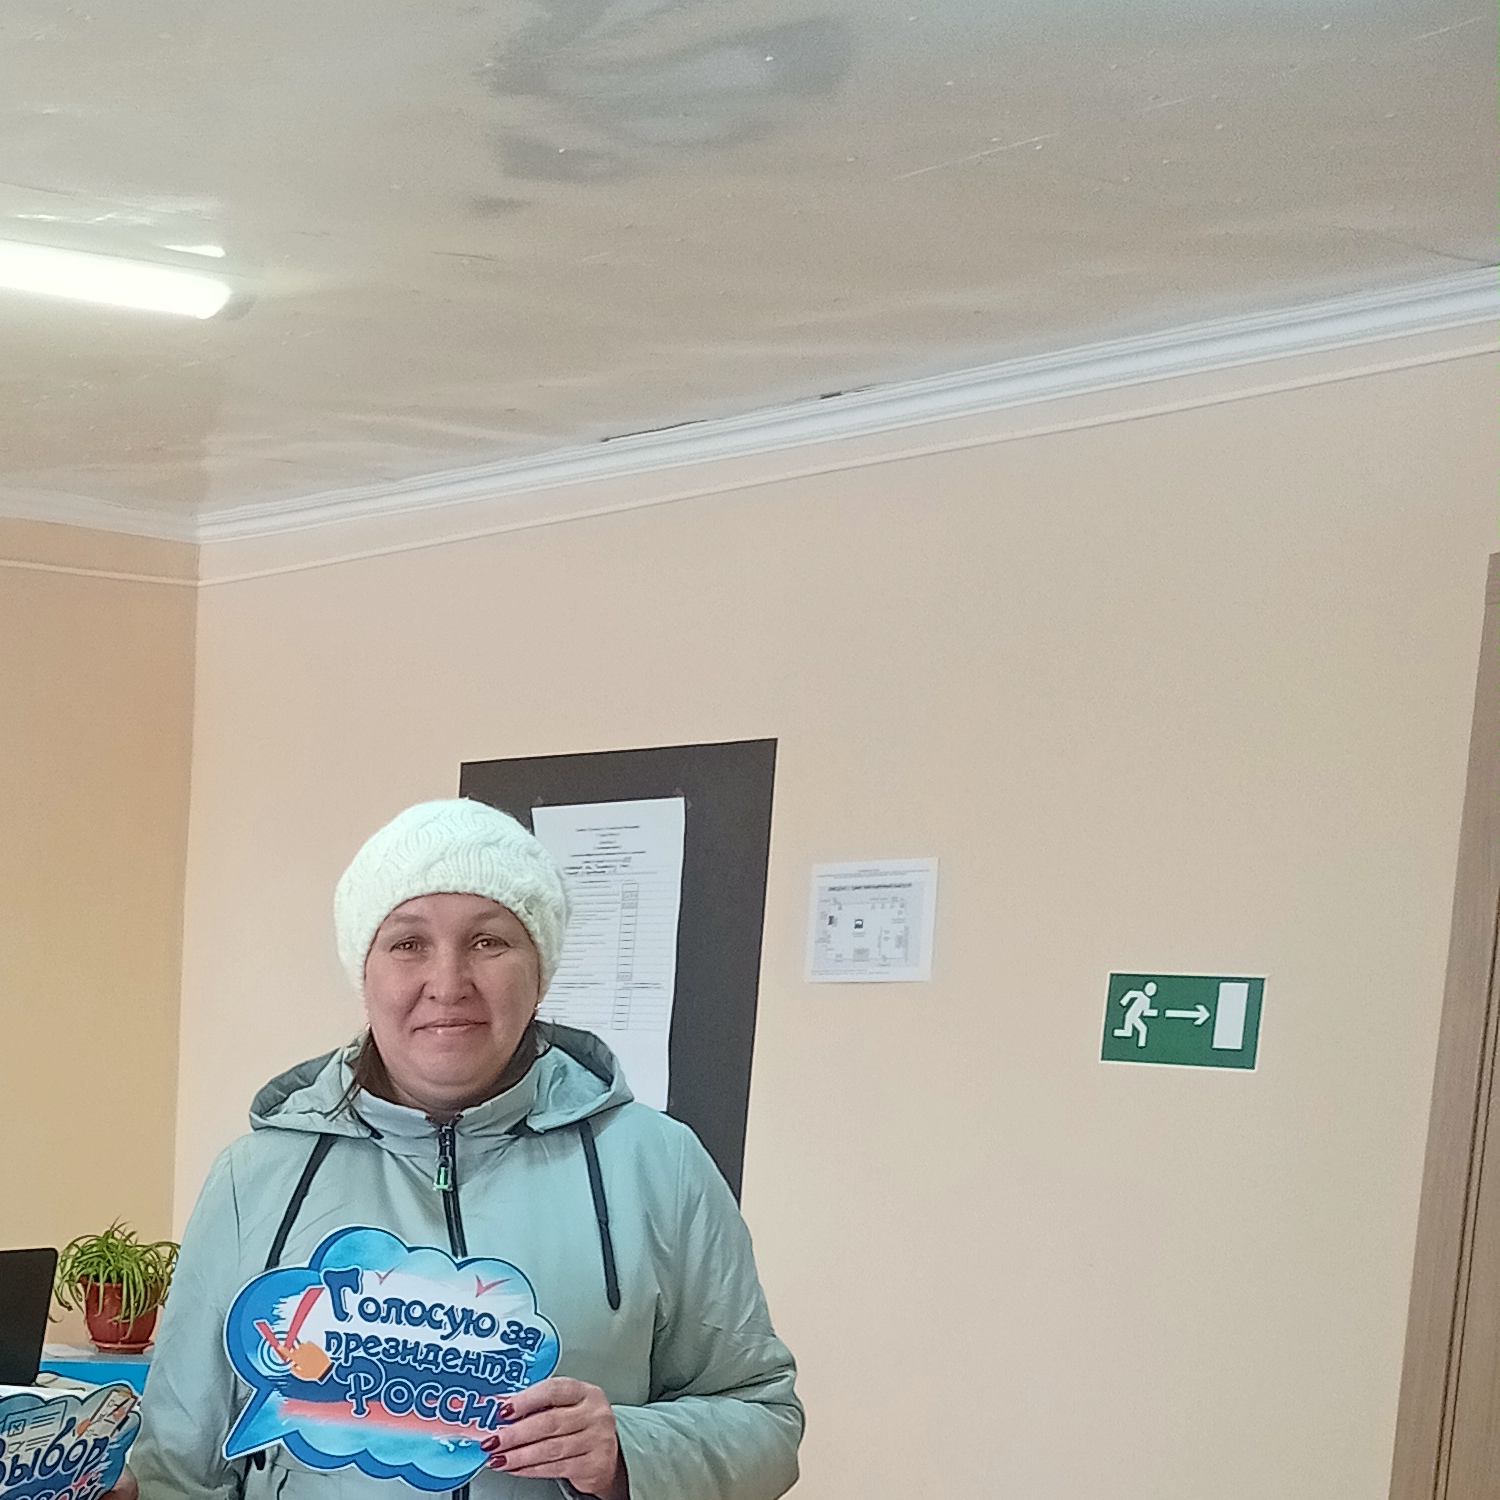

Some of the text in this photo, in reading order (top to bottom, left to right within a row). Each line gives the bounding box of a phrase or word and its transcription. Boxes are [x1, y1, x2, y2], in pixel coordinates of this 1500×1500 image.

[322, 1267, 544, 1353] Голосую за
[325, 1330, 525, 1384] президента
